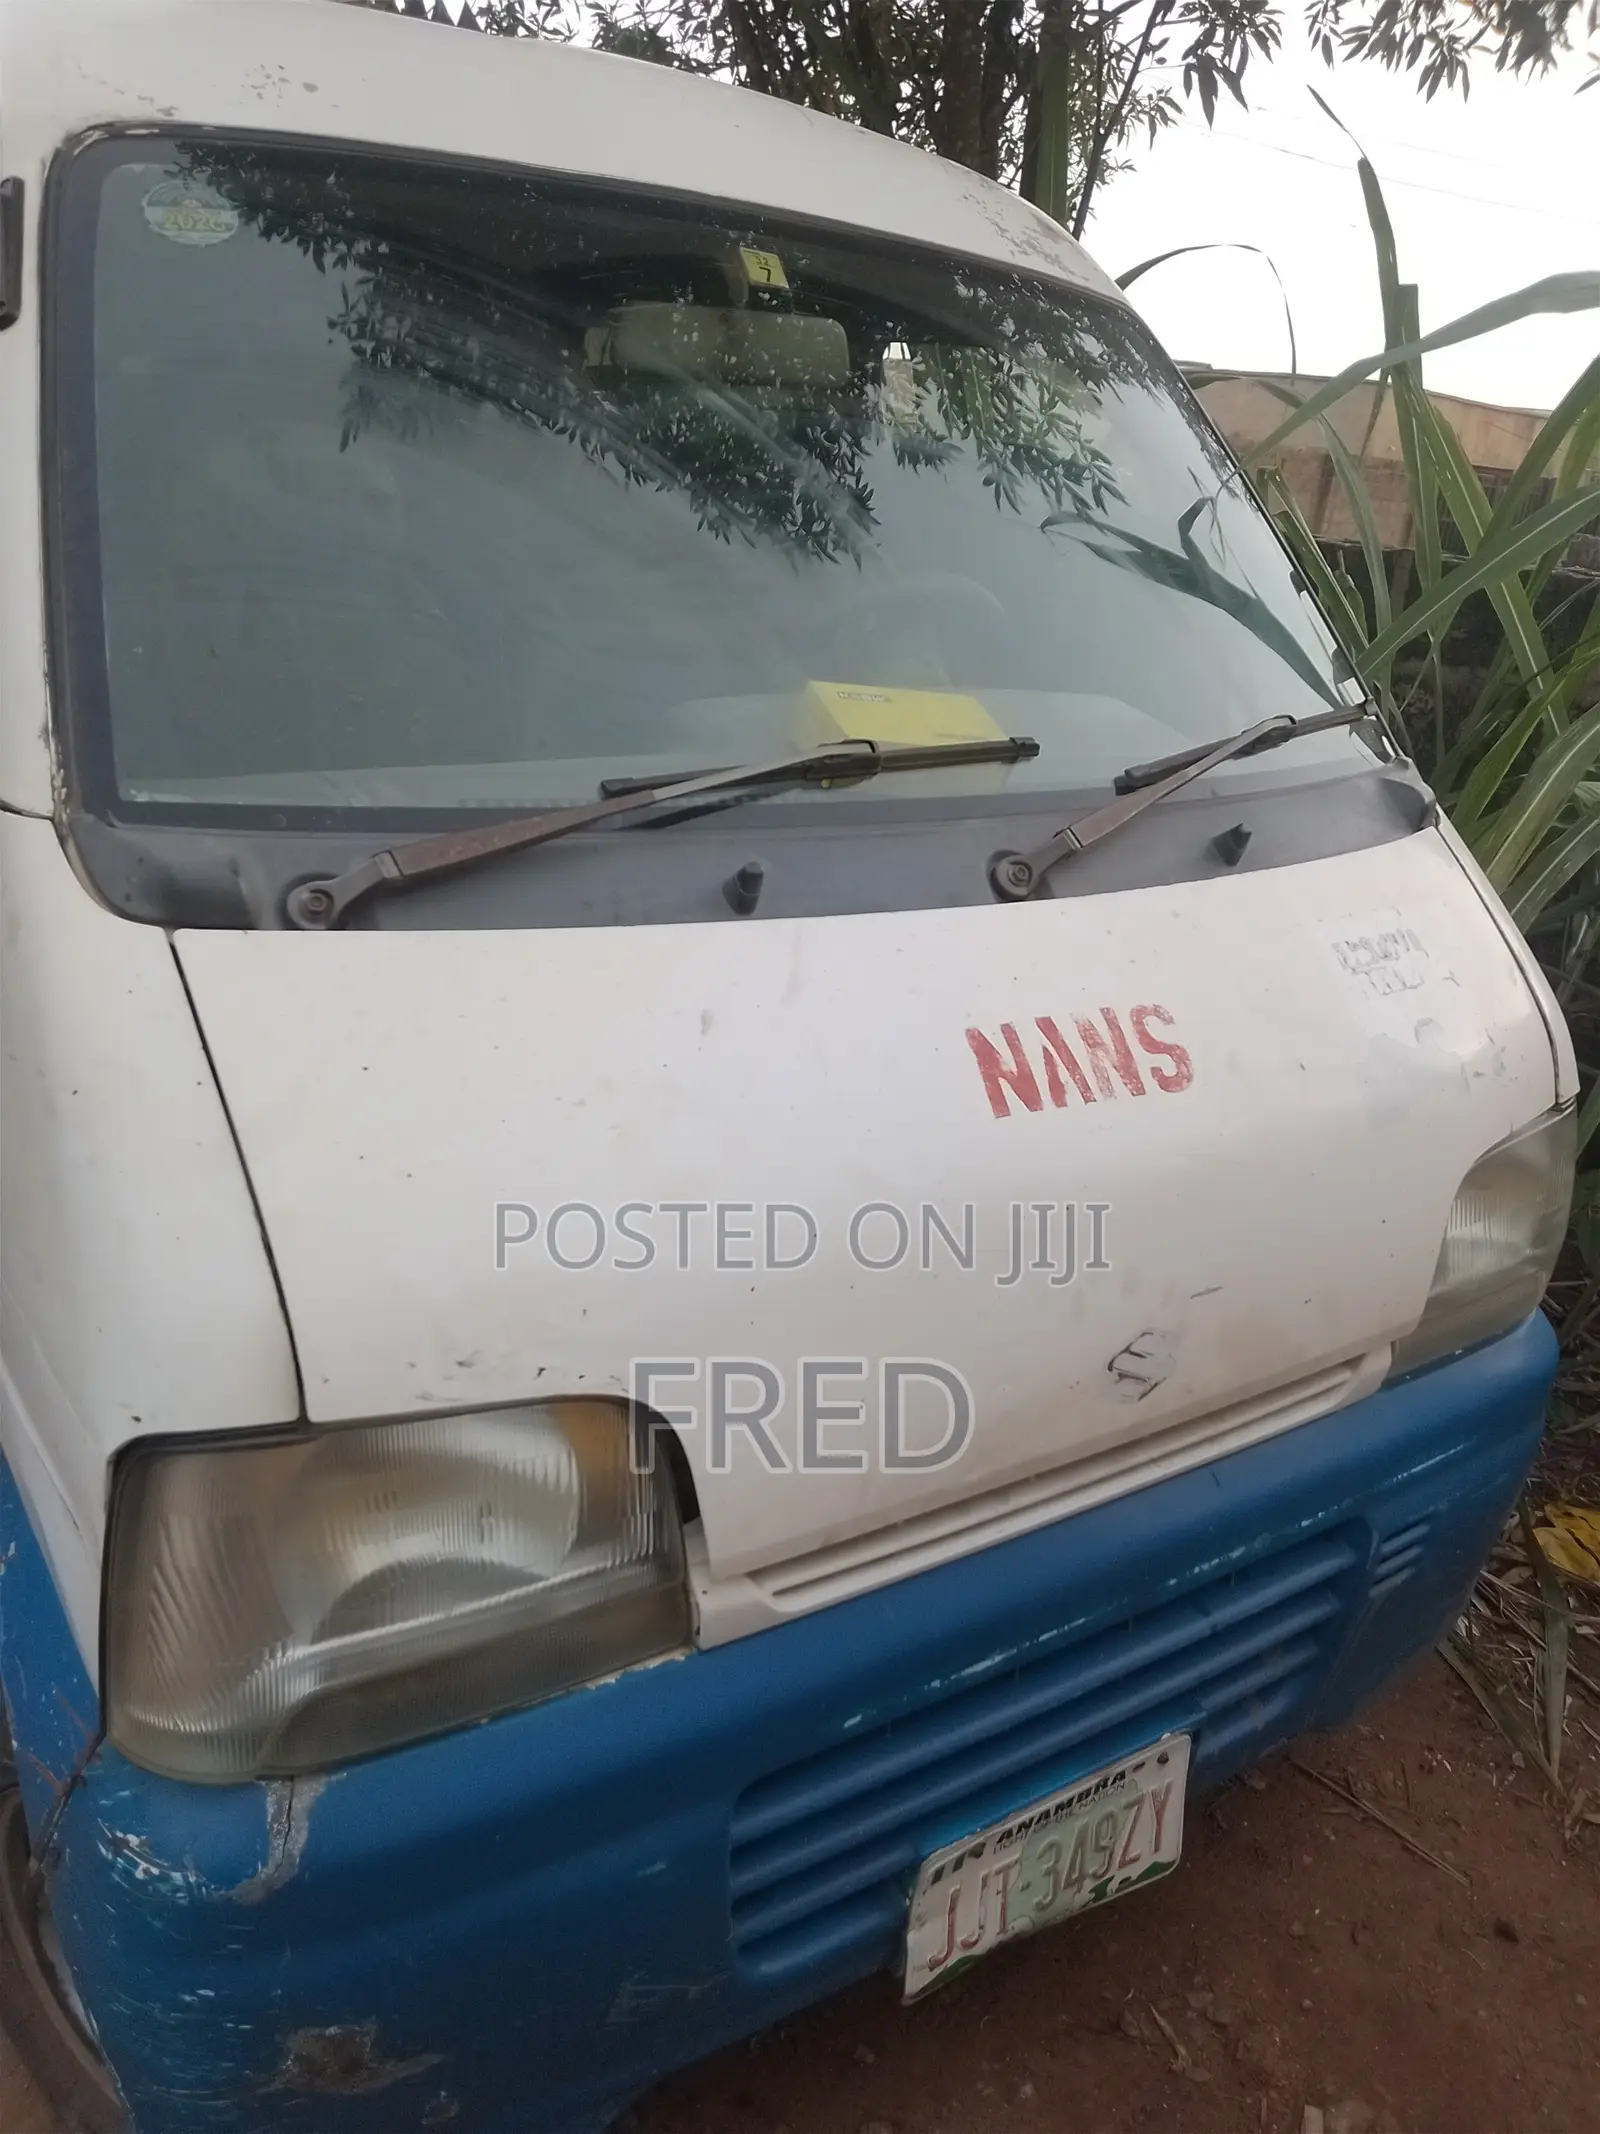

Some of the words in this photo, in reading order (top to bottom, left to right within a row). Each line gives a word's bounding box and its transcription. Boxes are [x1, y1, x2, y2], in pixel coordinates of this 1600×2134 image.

[759, 266, 771, 282] 7
[965, 1004, 1194, 1118] NANS
[997, 1769, 1127, 1844] ANAMBRA
